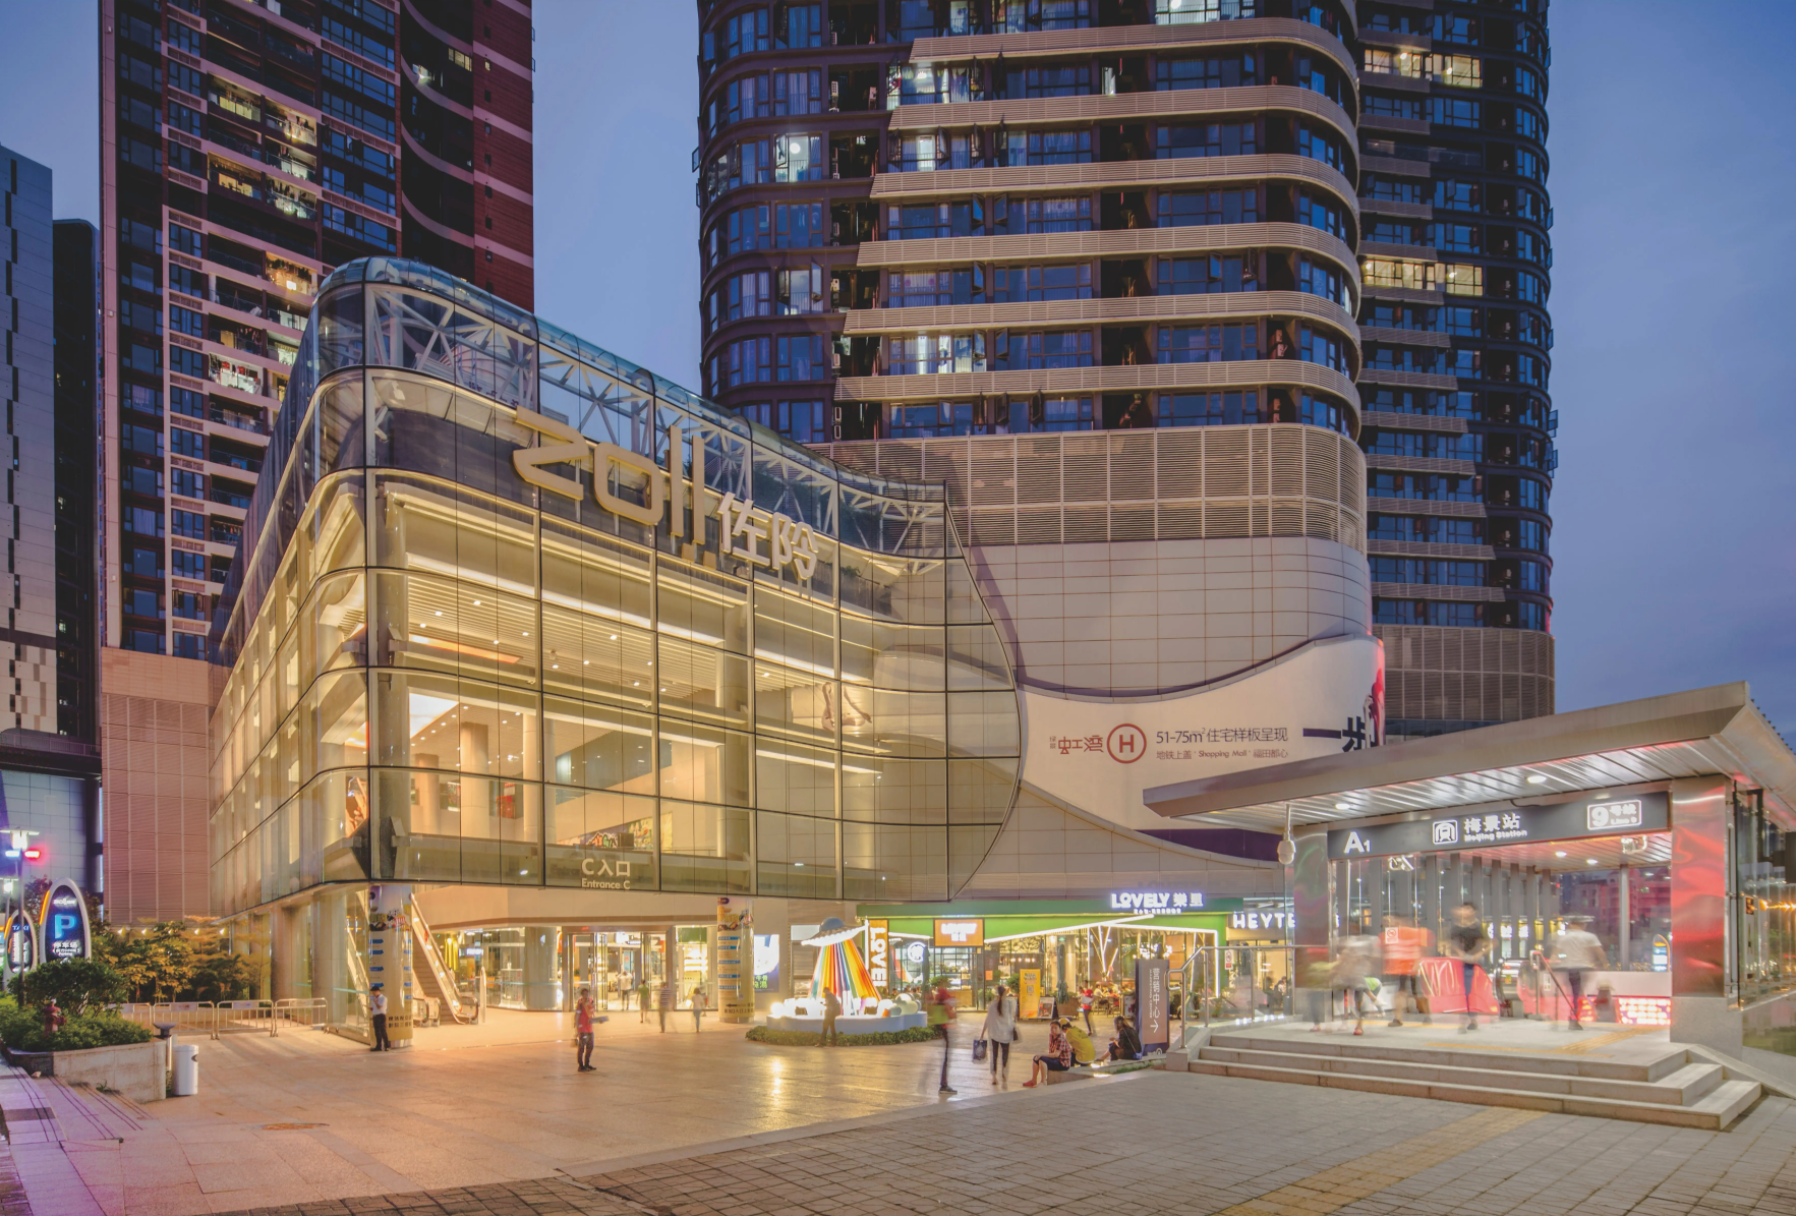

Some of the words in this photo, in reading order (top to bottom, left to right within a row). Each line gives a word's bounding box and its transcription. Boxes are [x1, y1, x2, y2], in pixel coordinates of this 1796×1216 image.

[1198, 750, 1229, 758] Shopping
[1463, 812, 1521, 833] 梅景站
[1496, 829, 1527, 840] Station
[1344, 831, 1371, 854] A1
[582, 878, 621, 889] Entrance
[623, 880, 630, 890] C
[1112, 893, 1170, 908] LOVELY
[55, 914, 76, 939] P
